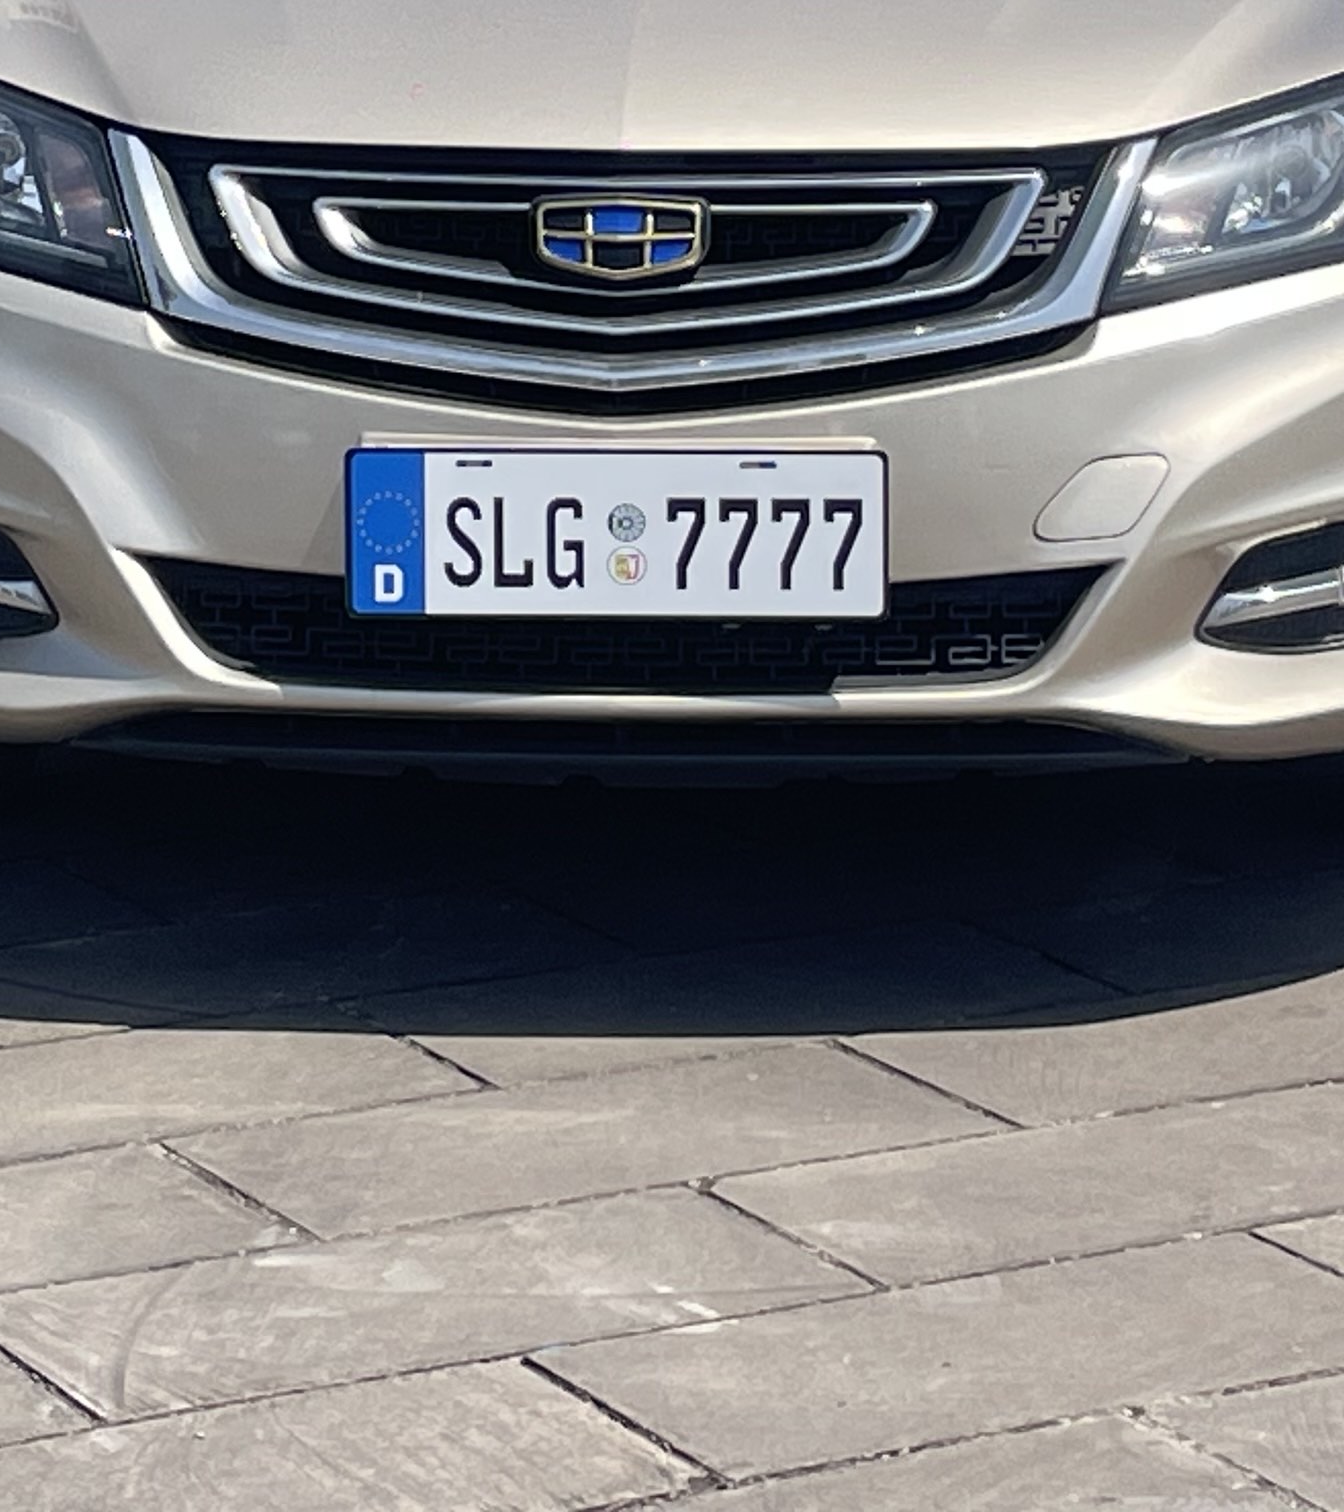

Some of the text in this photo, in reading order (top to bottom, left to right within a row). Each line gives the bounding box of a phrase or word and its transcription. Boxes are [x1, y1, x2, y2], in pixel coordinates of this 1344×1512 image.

[374, 496, 862, 603] D SLG 7777
